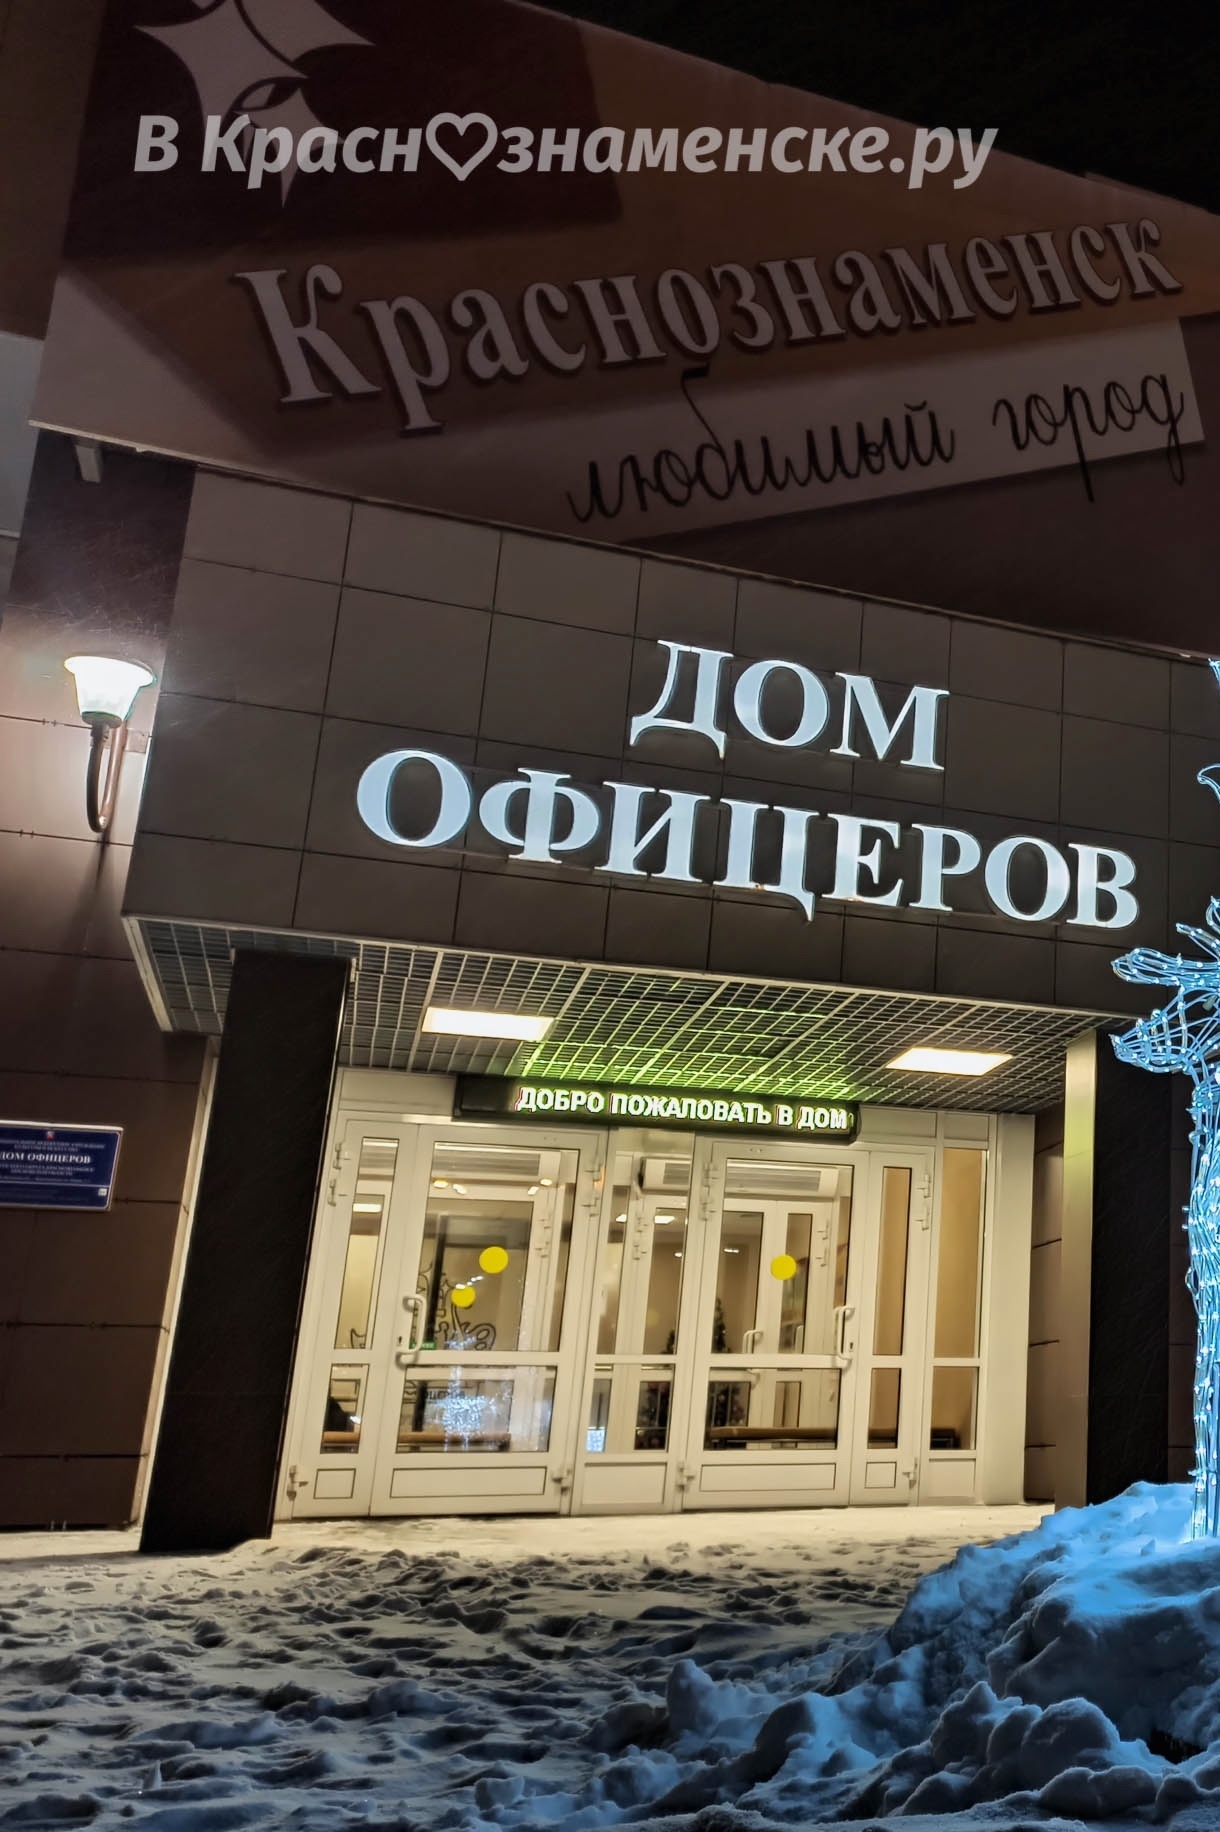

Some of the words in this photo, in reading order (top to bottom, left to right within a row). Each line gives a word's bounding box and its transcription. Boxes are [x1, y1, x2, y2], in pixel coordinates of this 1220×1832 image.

[233, 217, 1184, 433] Краснознаменск
[565, 366, 956, 524] любимый
[991, 372, 1184, 503] город
[630, 640, 949, 770] ДОМ
[357, 750, 1138, 929] ОФИЦЕРОВ
[26, 1153, 92, 1165] ОФИЦЕРОВ
[514, 1086, 605, 1113] ДОБРО
[610, 1092, 772, 1124] ПОЖАЛОВАТЬ
[777, 1104, 794, 1126] В
[797, 1106, 848, 1131] ДОМ
